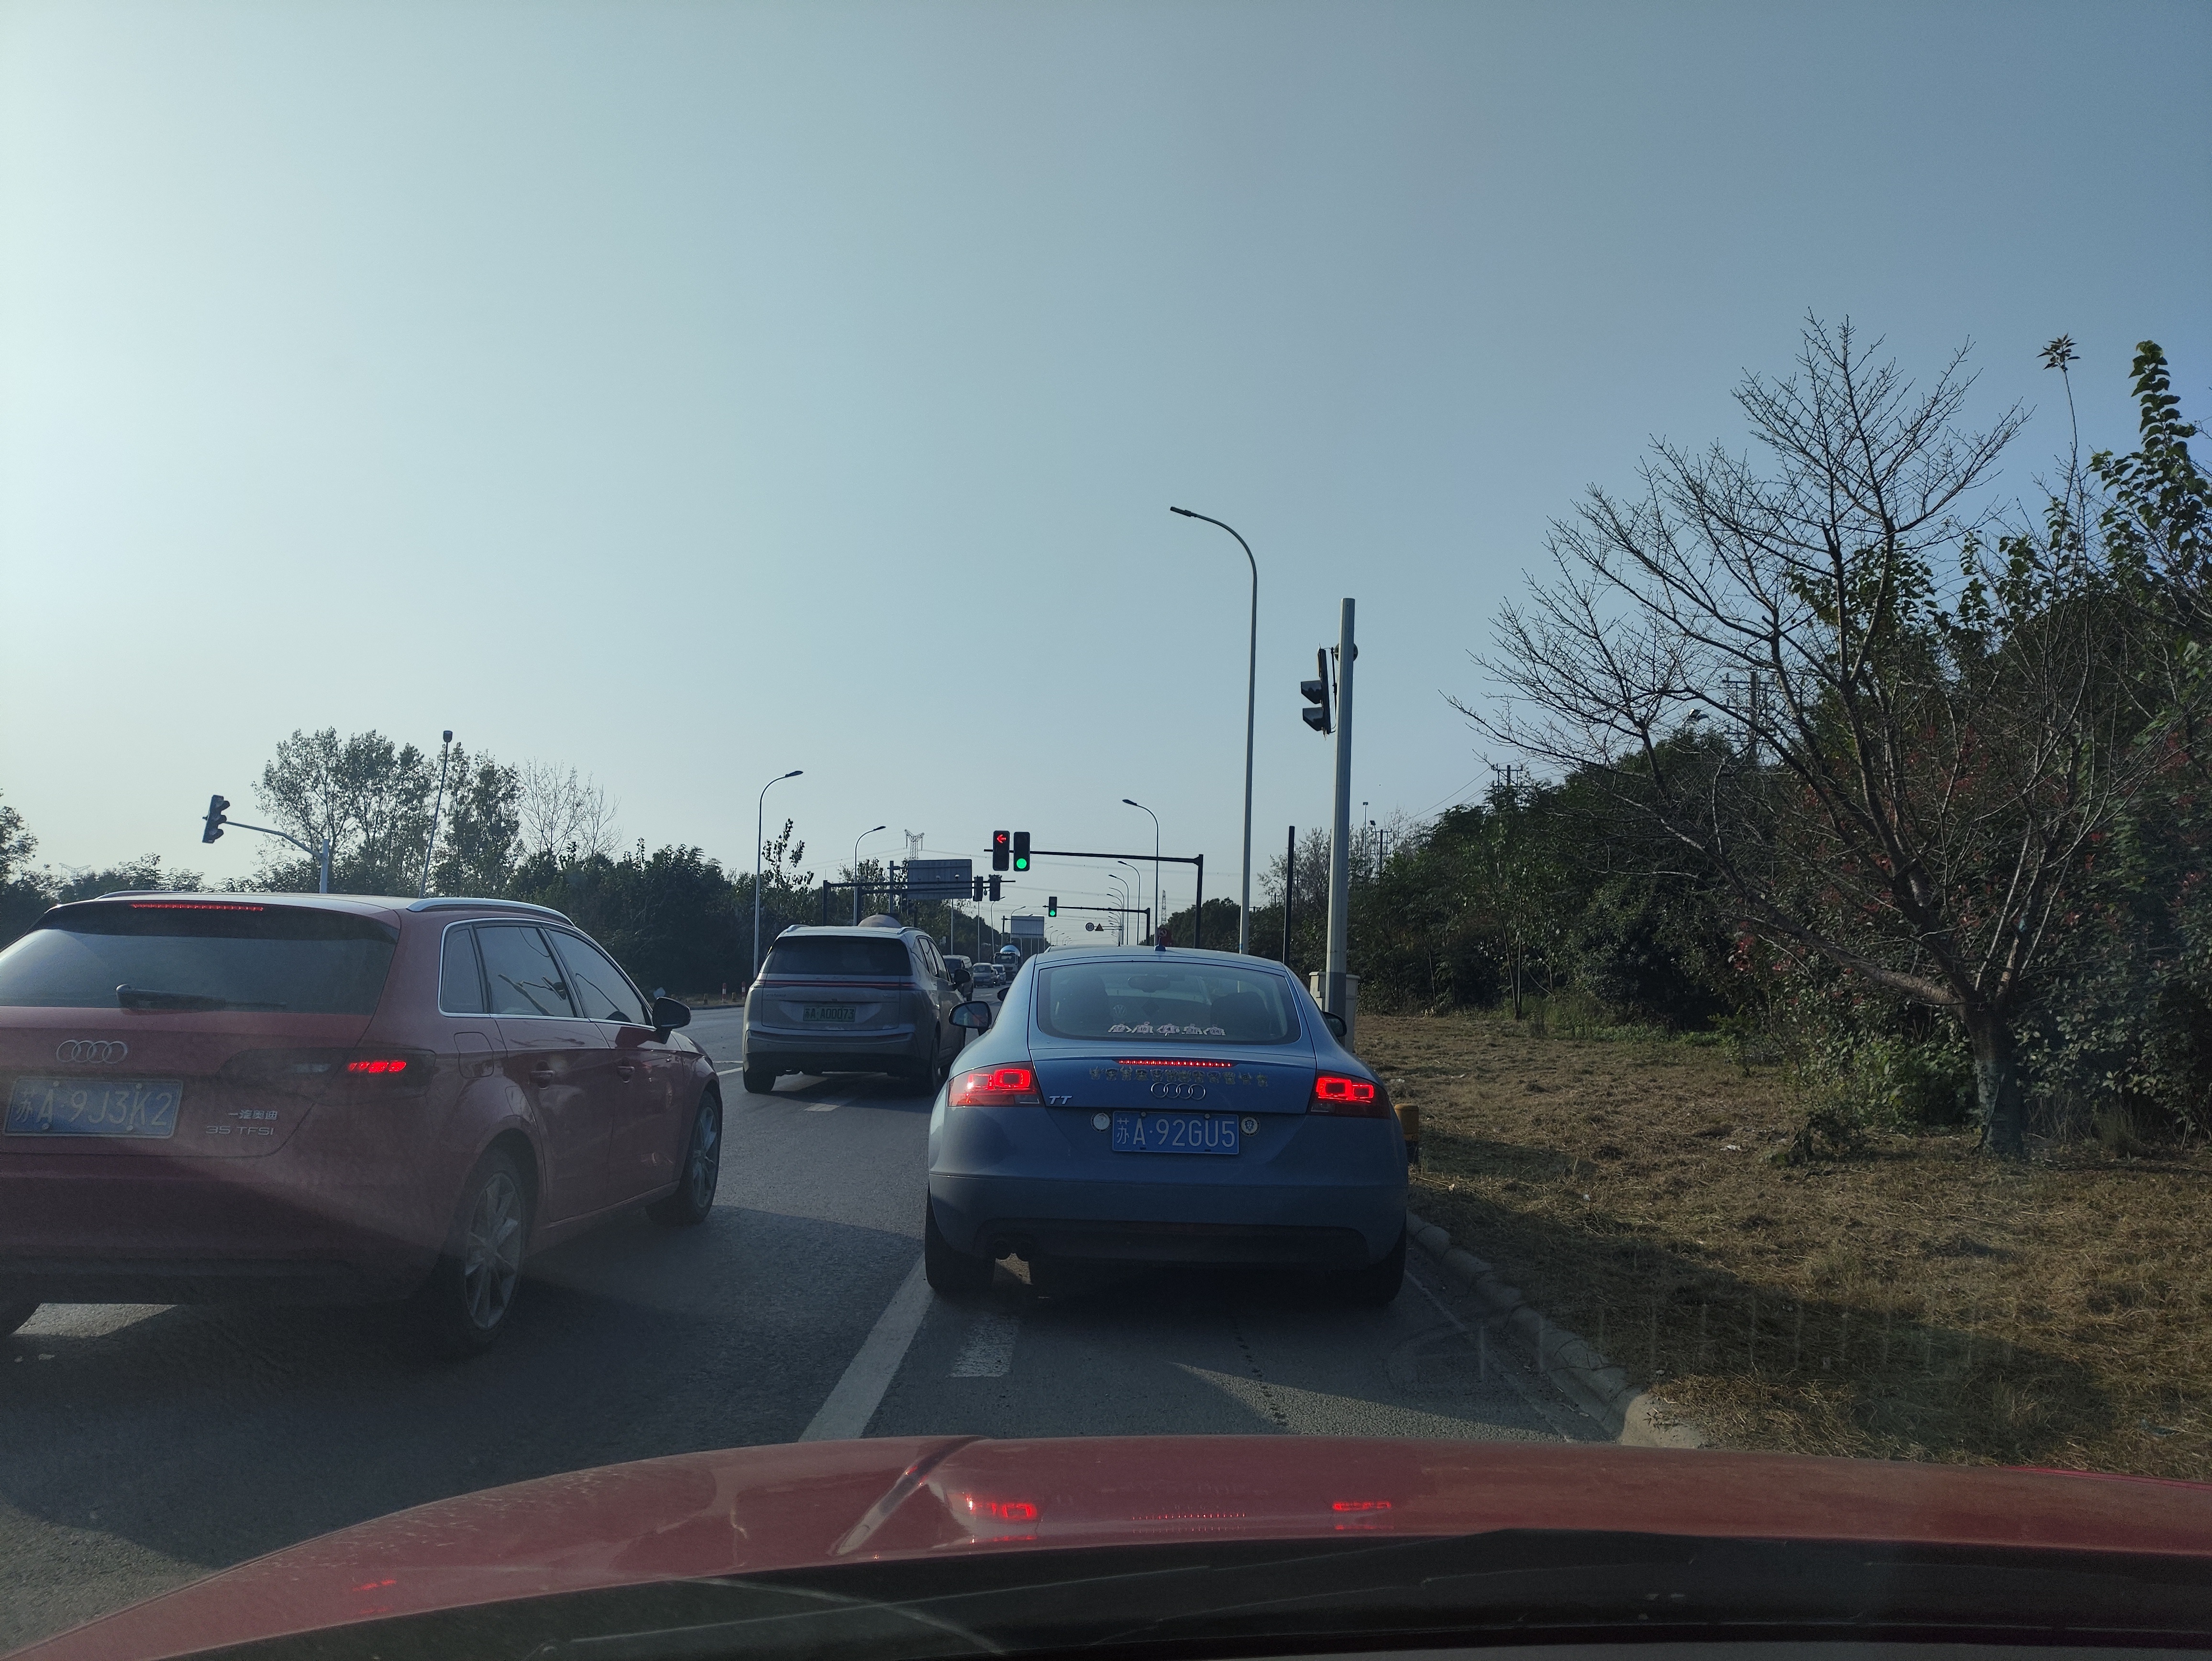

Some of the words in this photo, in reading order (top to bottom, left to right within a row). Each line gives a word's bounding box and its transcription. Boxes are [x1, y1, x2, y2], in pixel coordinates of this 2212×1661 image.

[1049, 1096, 1073, 1105] TT
[228, 1109, 278, 1120] 一汽奥迪
[206, 1126, 231, 1134] 35
[236, 1126, 274, 1136] TFSI
